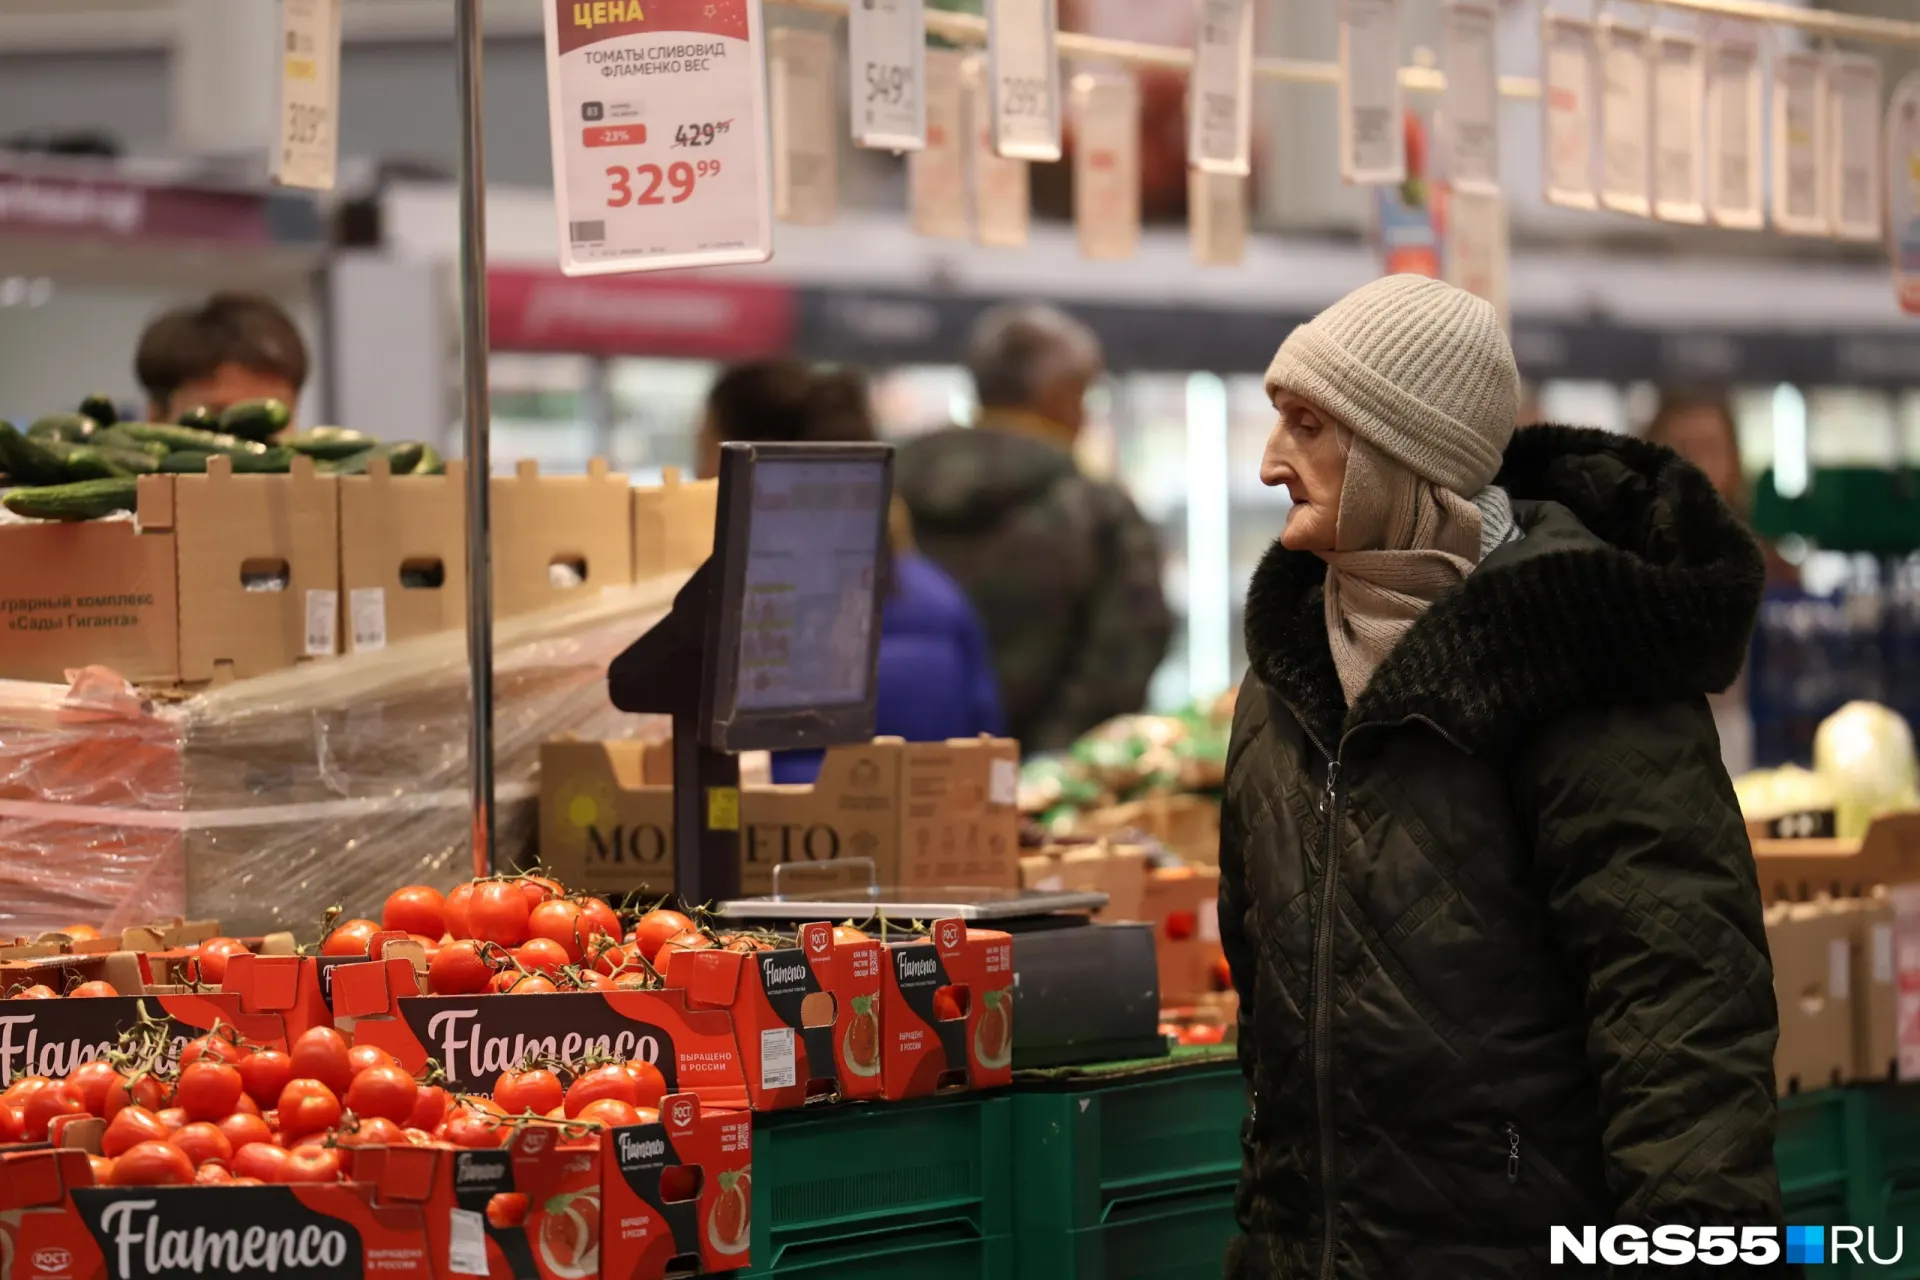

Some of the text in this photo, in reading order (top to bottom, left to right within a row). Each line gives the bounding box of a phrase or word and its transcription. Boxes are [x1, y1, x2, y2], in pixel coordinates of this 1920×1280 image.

[574, 0, 645, 30] ЦЕНА
[585, 43, 727, 64] ТОМАТЫ СЛИВОВИД
[601, 58, 710, 78] ФЛАМЕНКО ВЕС
[600, 131, 629, 143] -23%
[0, 593, 154, 613] грарный комплекс
[763, 957, 806, 988] Flamenco
[897, 951, 937, 980] Flamenco
[427, 1008, 659, 1082] Flamenco
[680, 1052, 732, 1063] ВЫРАЩЕНО
[681, 1062, 727, 1072] В РОССИИ
[618, 1132, 665, 1163] Flamenco
[101, 1199, 347, 1280] Flamenco
